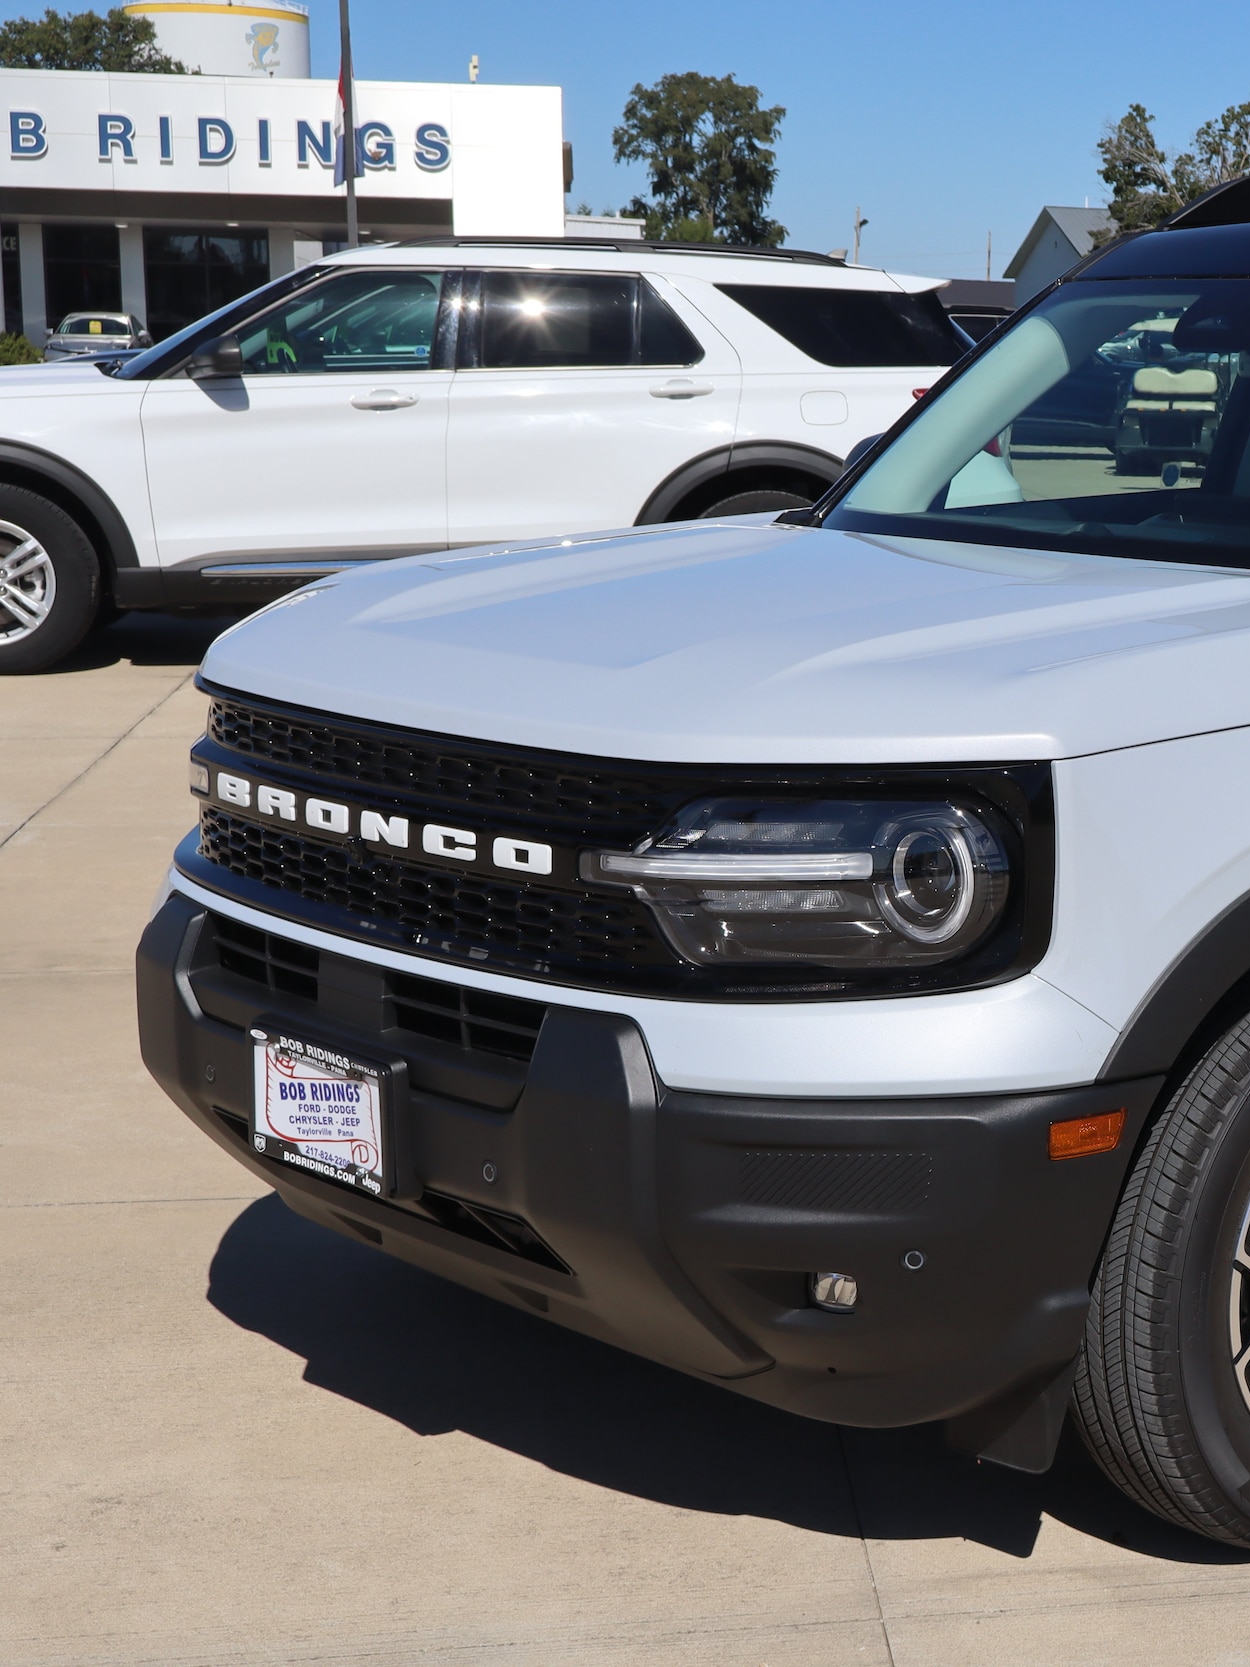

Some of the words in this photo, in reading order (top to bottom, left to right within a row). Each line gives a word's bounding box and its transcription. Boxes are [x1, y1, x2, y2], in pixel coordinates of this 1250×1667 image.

[8, 110, 47, 158] B
[97, 112, 451, 171] RIDINGS
[216, 772, 552, 875] BRONCO
[280, 1035, 304, 1053] BOB
[305, 1044, 351, 1070] RIDINGS
[287, 1050, 326, 1069] TAYLORVILLE
[331, 1065, 347, 1077] PANA
[351, 1062, 378, 1077] CHRYSLER
[279, 1082, 306, 1101] BOB
[310, 1083, 360, 1103] RIDINGS
[298, 1104, 321, 1113] FORD
[328, 1104, 357, 1114] DODGE
[289, 1115, 334, 1125] CHRYSLER
[341, 1117, 360, 1127] JEEP
[297, 1127, 332, 1136] Taylorville
[338, 1129, 354, 1137] Pana
[283, 1150, 356, 1186] BOBRIDINGS.COM
[362, 1172, 381, 1195] Jeep
